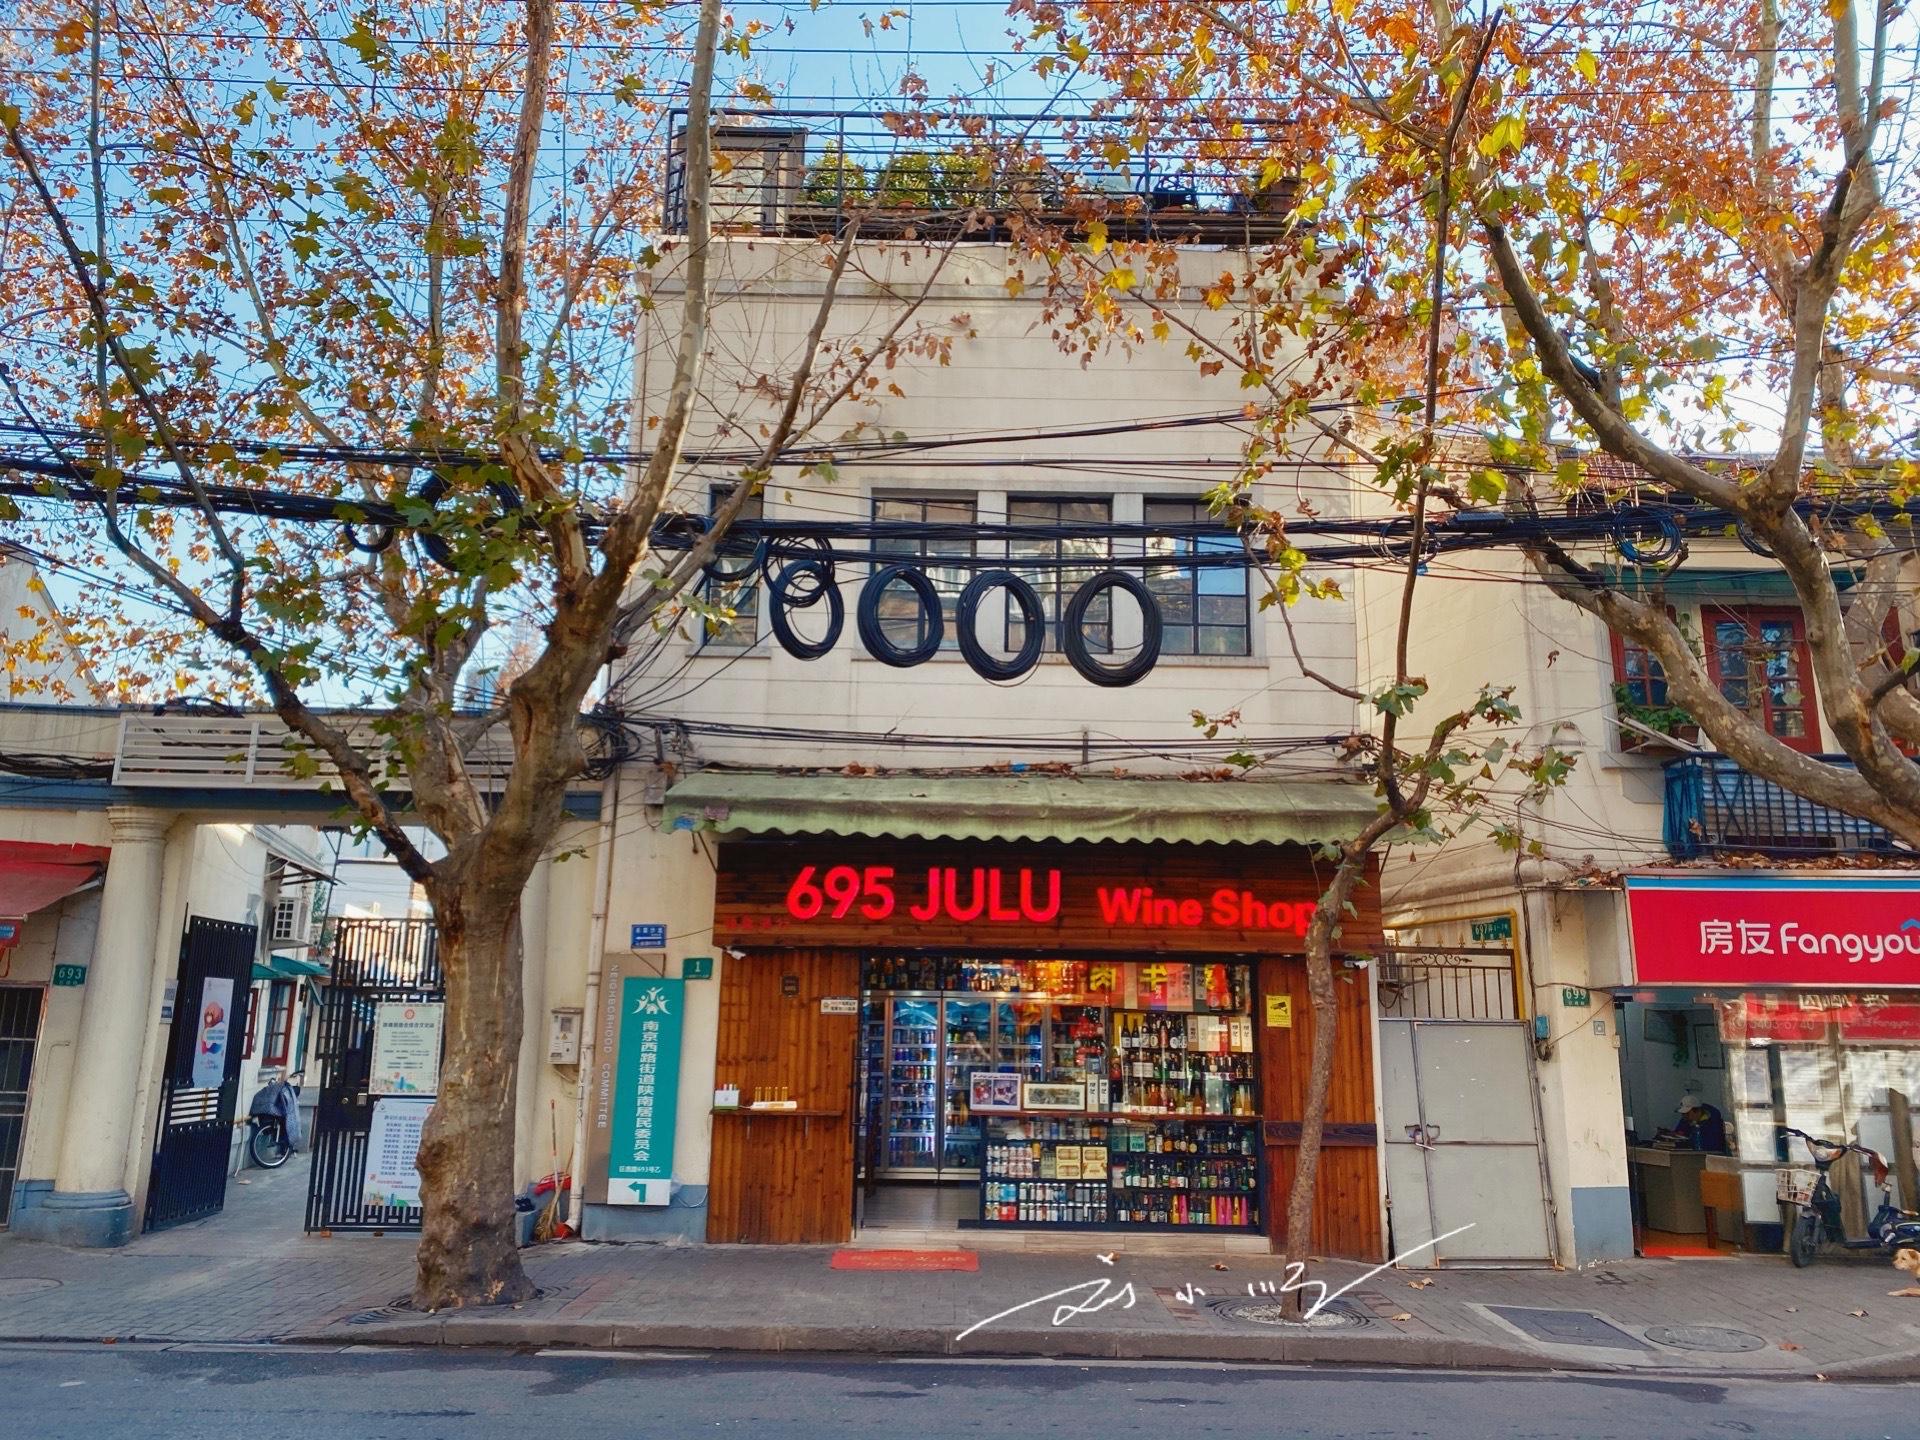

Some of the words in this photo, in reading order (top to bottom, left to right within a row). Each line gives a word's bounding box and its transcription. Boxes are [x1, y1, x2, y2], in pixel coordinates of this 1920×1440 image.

[787, 866, 895, 920] 695
[910, 867, 1061, 922] JULU
[1097, 887, 1204, 926] Wine
[1211, 888, 1318, 937] Shop
[1700, 919, 1775, 955] 房友
[58, 967, 82, 980] 693
[694, 960, 702, 972] 1
[603, 964, 619, 1053] NEIGHBORHOOD
[1565, 987, 1587, 1000] 699
[597, 1063, 611, 1128] COMMITTEE
[633, 1020, 658, 1161] 南京西路街道陕南居民委员会
